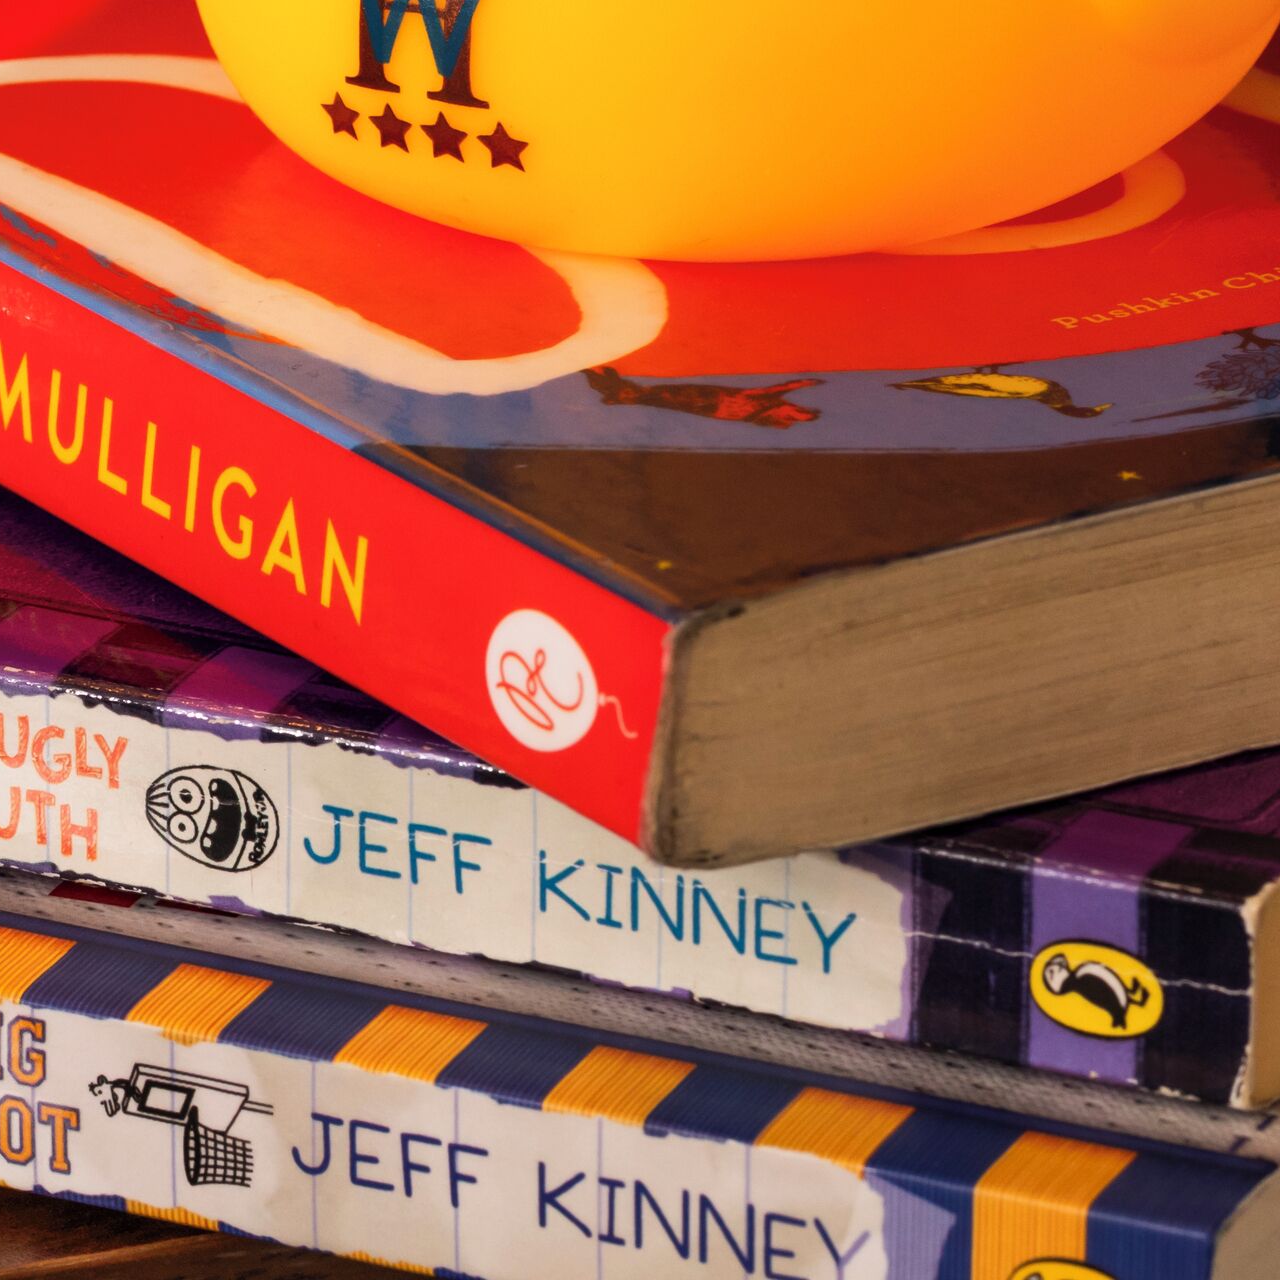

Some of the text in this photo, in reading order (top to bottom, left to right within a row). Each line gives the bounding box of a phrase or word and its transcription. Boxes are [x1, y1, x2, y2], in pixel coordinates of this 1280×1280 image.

[1051, 286, 1220, 330] Pushkin
[303, 804, 857, 975] JEFF KINNEY
[292, 1113, 870, 1280] JEFF KINNEY
